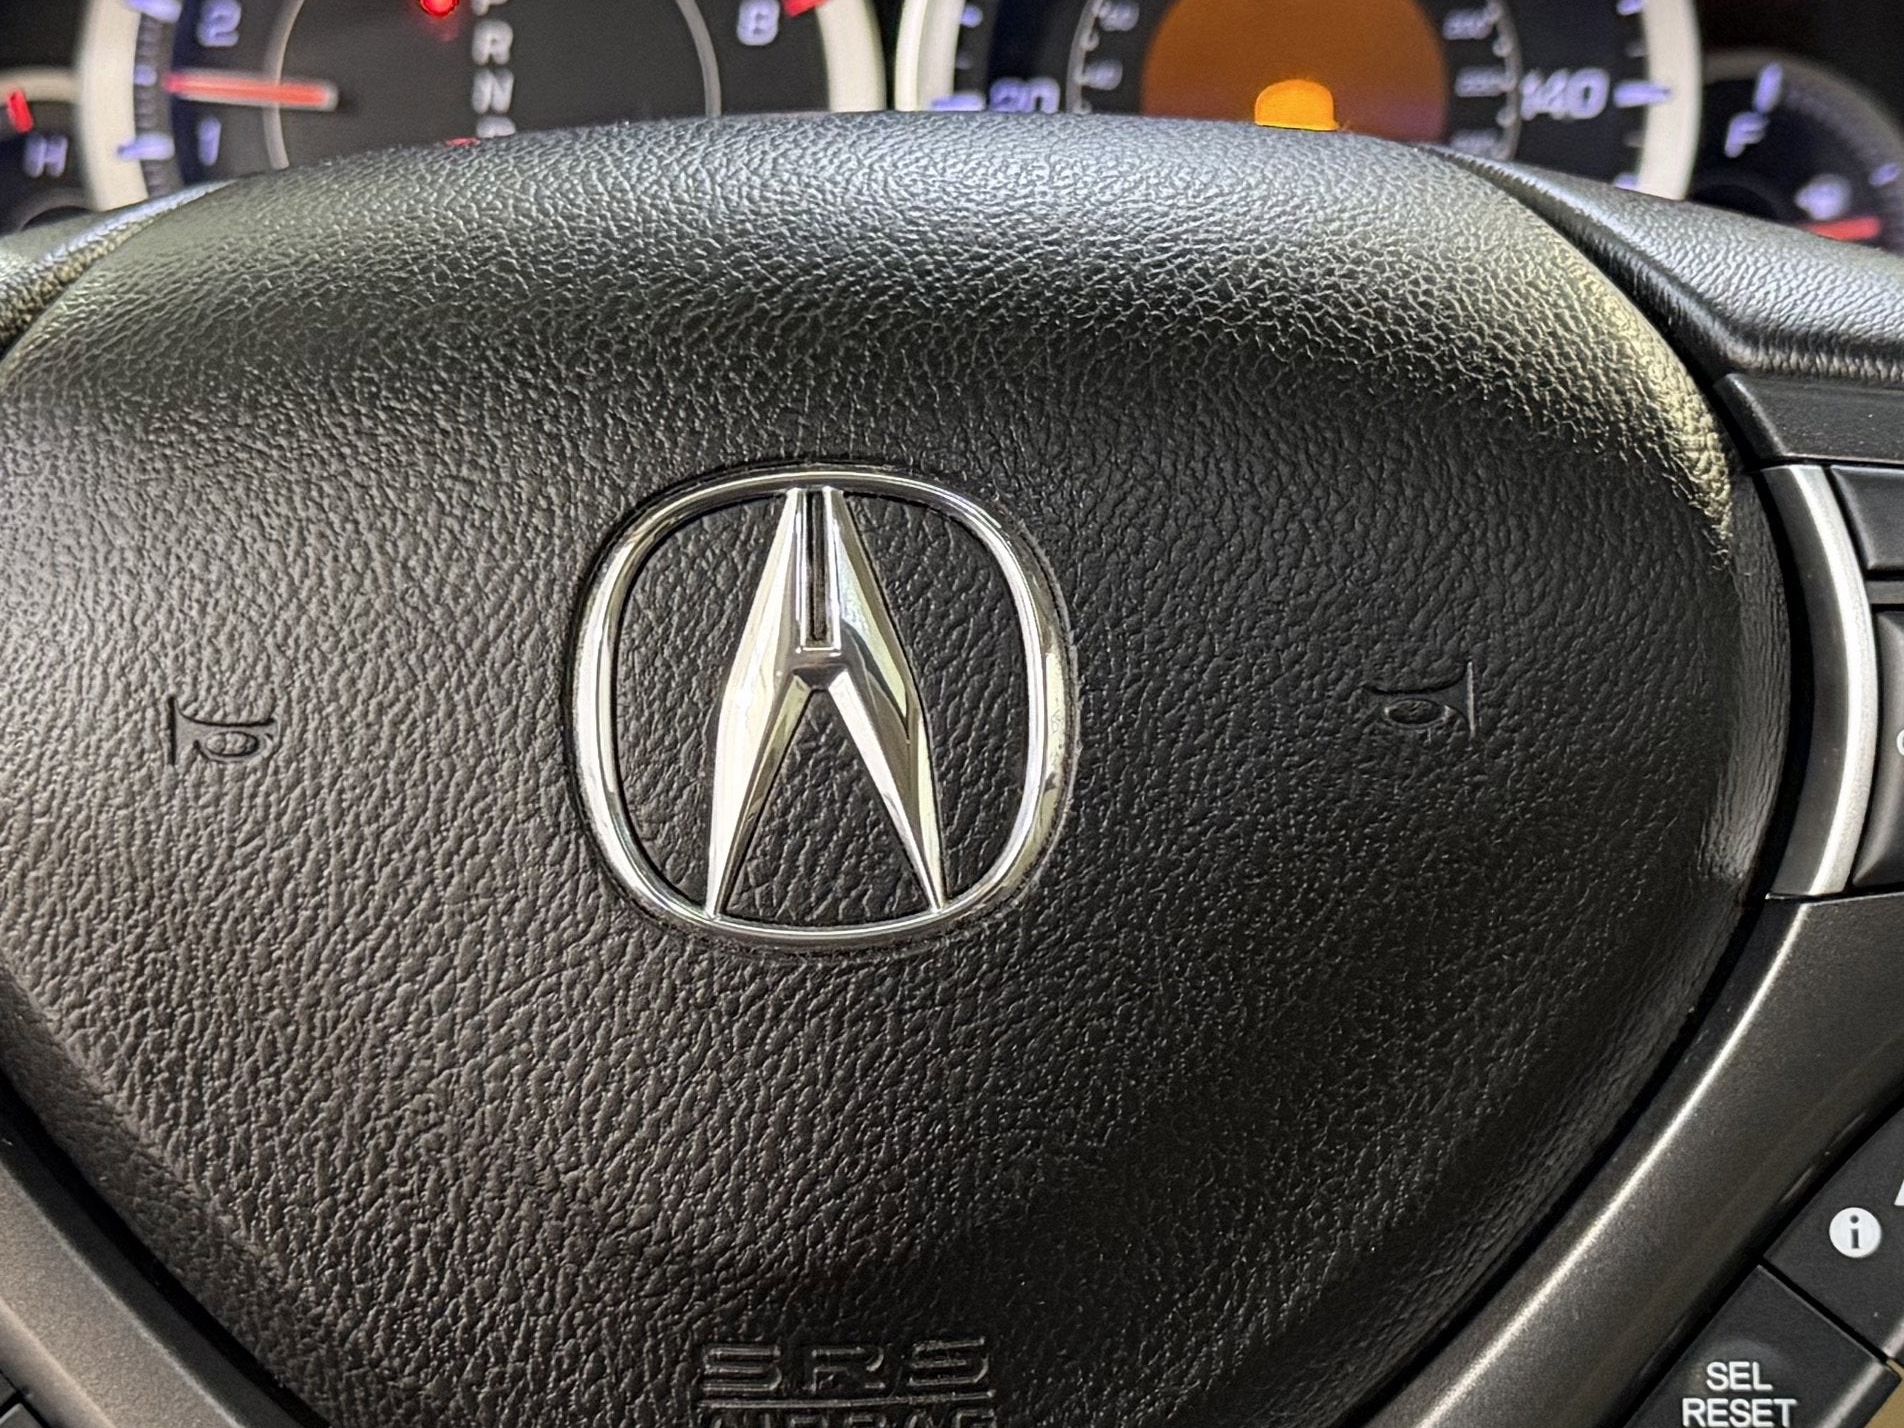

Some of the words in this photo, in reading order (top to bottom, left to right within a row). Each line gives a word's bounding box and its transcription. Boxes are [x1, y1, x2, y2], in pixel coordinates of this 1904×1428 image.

[472, 19, 514, 65] R
[472, 68, 514, 114] N
[1520, 68, 1611, 121] 140
[24, 132, 68, 178] H
[197, 117, 222, 166] 1
[1705, 1360, 1774, 1393] SEL
[1680, 1396, 1798, 1428] RESET
